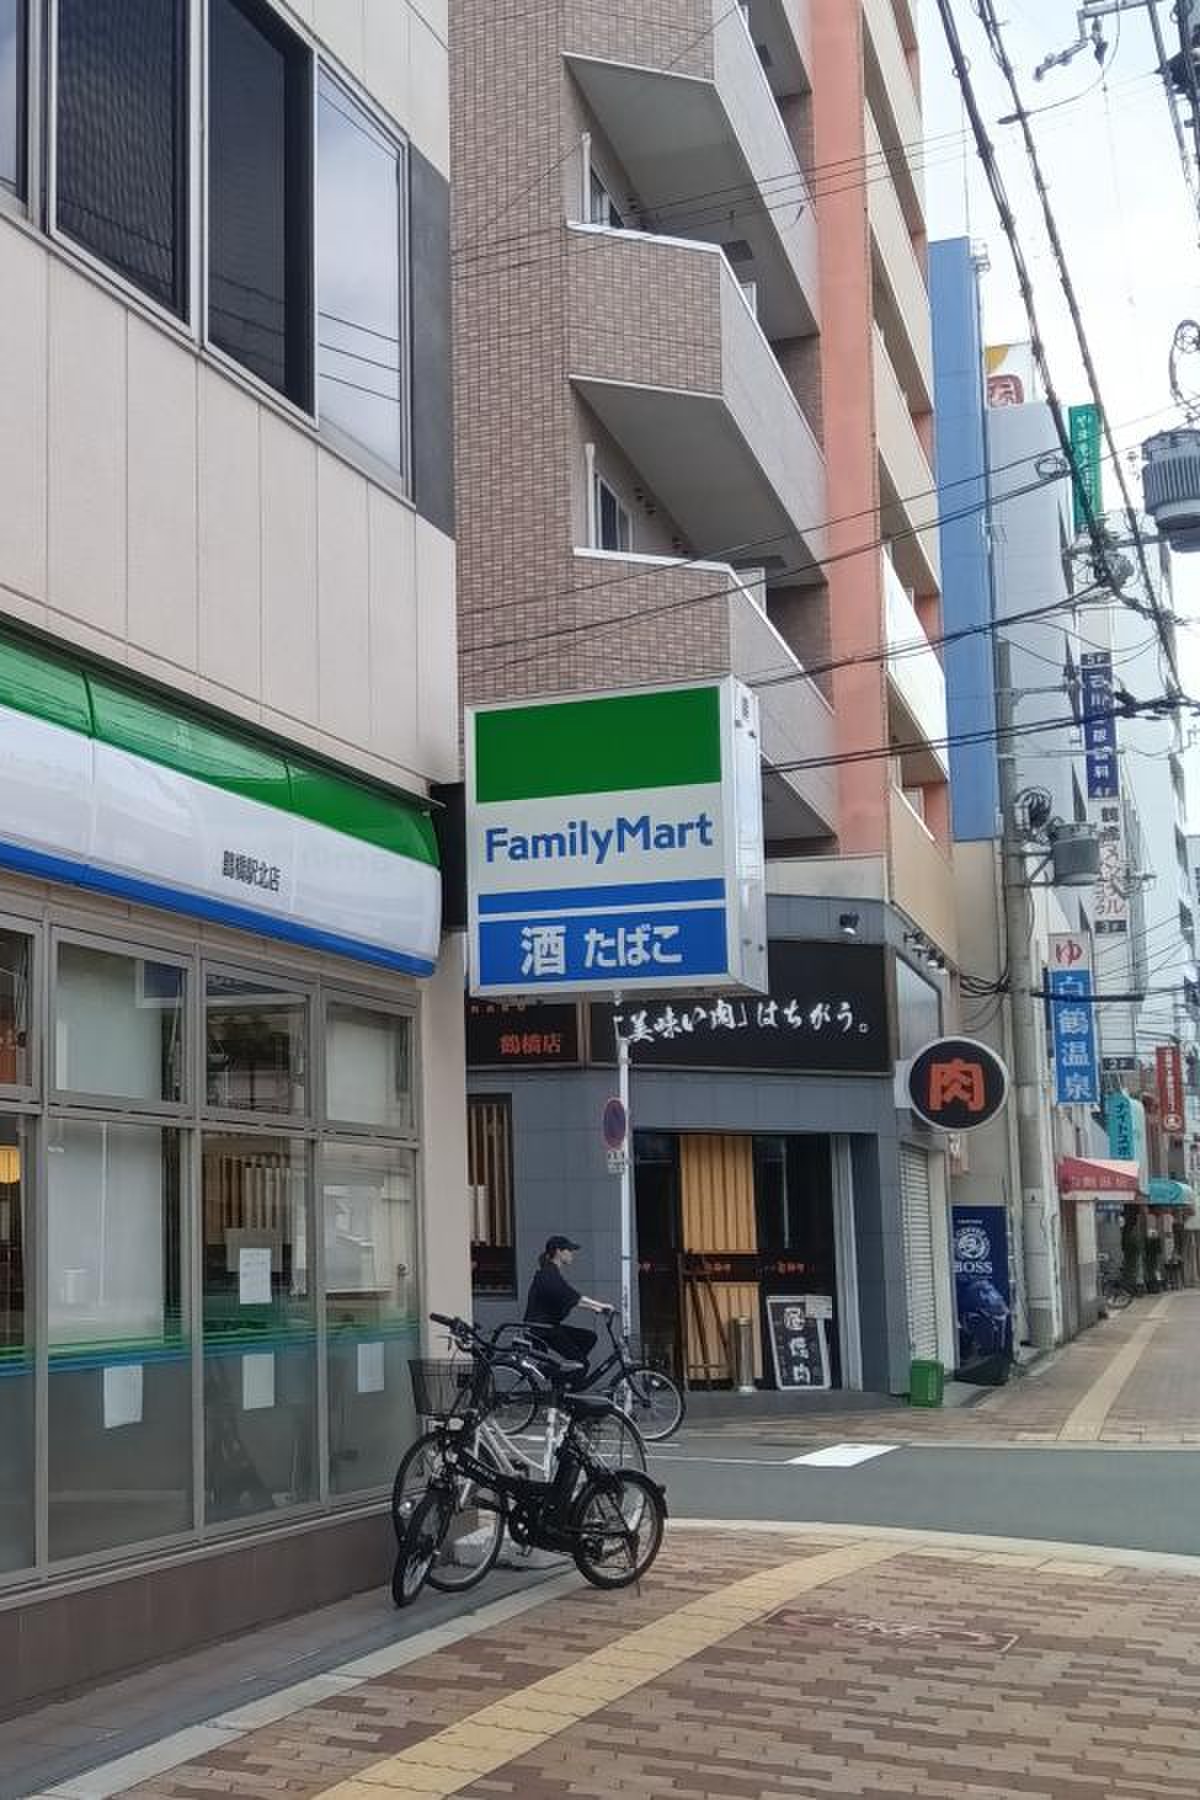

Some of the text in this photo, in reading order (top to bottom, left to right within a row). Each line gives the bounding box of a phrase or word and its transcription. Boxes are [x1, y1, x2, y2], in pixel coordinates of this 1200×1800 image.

[485, 812, 713, 864] FamilyMart
[521, 923, 683, 976] 酒 たばこ
[1055, 939, 1083, 967] ゆ
[929, 1057, 986, 1112] 肉
